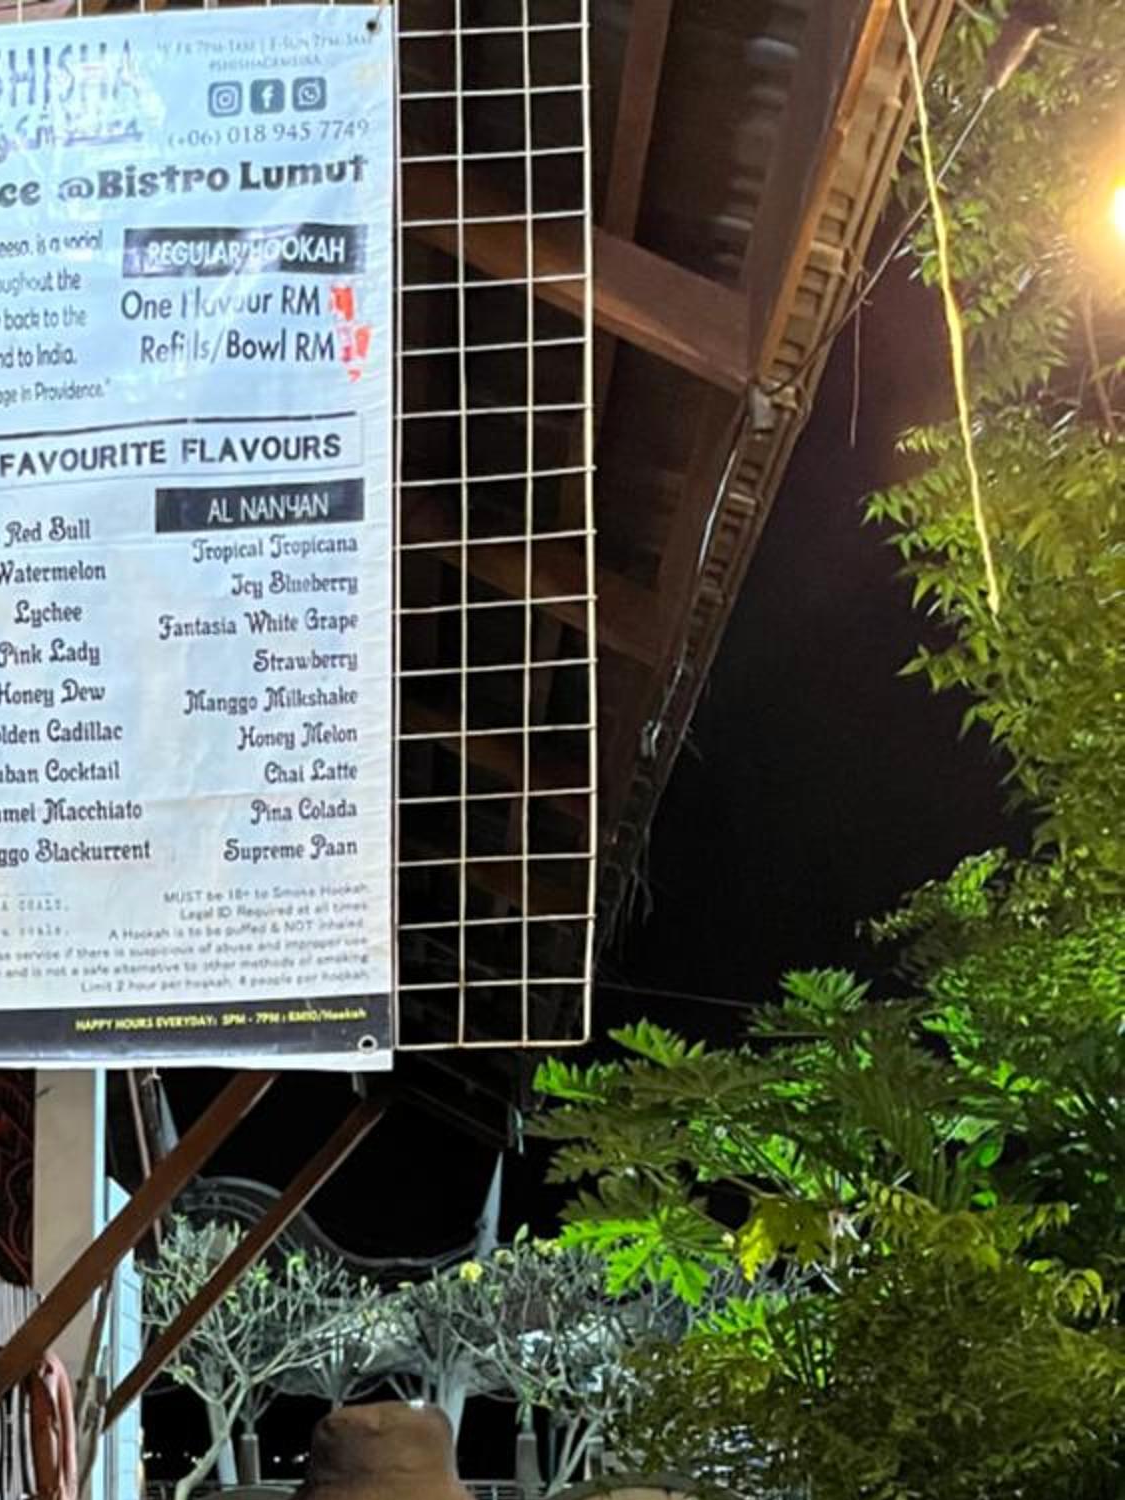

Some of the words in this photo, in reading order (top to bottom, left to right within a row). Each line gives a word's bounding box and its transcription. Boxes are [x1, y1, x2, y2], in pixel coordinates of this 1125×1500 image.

[227, 124, 267, 144] 018
[272, 120, 312, 141] 945
[318, 117, 370, 139] 7749
[57, 164, 230, 202] @Bistro
[239, 154, 369, 191] Lumut
[36, 233, 46, 254] is
[147, 239, 242, 268] REGULAR
[249, 236, 347, 264] HOOKAH
[57, 268, 81, 291] the
[43, 308, 59, 329] to
[62, 304, 87, 327] the
[121, 289, 172, 321] One
[282, 284, 321, 317] RM
[17, 345, 34, 368] to
[295, 331, 336, 362] RM
[181, 434, 342, 464] FLAVOURS
[207, 497, 234, 525] AL
[3, 520, 43, 547] Red
[49, 516, 91, 542] Bull
[191, 538, 264, 564] Tropical
[268, 533, 359, 559] Tropicana
[268, 569, 359, 597] Blueberry
[13, 600, 83, 628] Lychee
[158, 613, 237, 640] Fantasia
[243, 607, 299, 635] White
[305, 606, 359, 634] Grape
[48, 637, 101, 667] Lady
[252, 648, 359, 673] Strawberry
[61, 678, 107, 704] Dew
[183, 689, 259, 716] Manggo
[262, 684, 359, 712] Milkshake
[46, 717, 124, 743] Cadillac
[236, 724, 296, 751] Honey
[300, 721, 359, 747] Melon
[44, 757, 121, 783] Cocktail
[264, 760, 305, 784] Chai
[310, 757, 359, 782] Latte
[41, 797, 143, 825] Macchiato
[250, 799, 293, 826] Pina
[298, 796, 358, 821] Colada
[34, 837, 151, 864] Blackurrent
[222, 837, 306, 864] Supreme
[310, 833, 359, 860] Paan
[75, 1018, 113, 1032] HAPPY
[115, 1017, 154, 1031] HOURS
